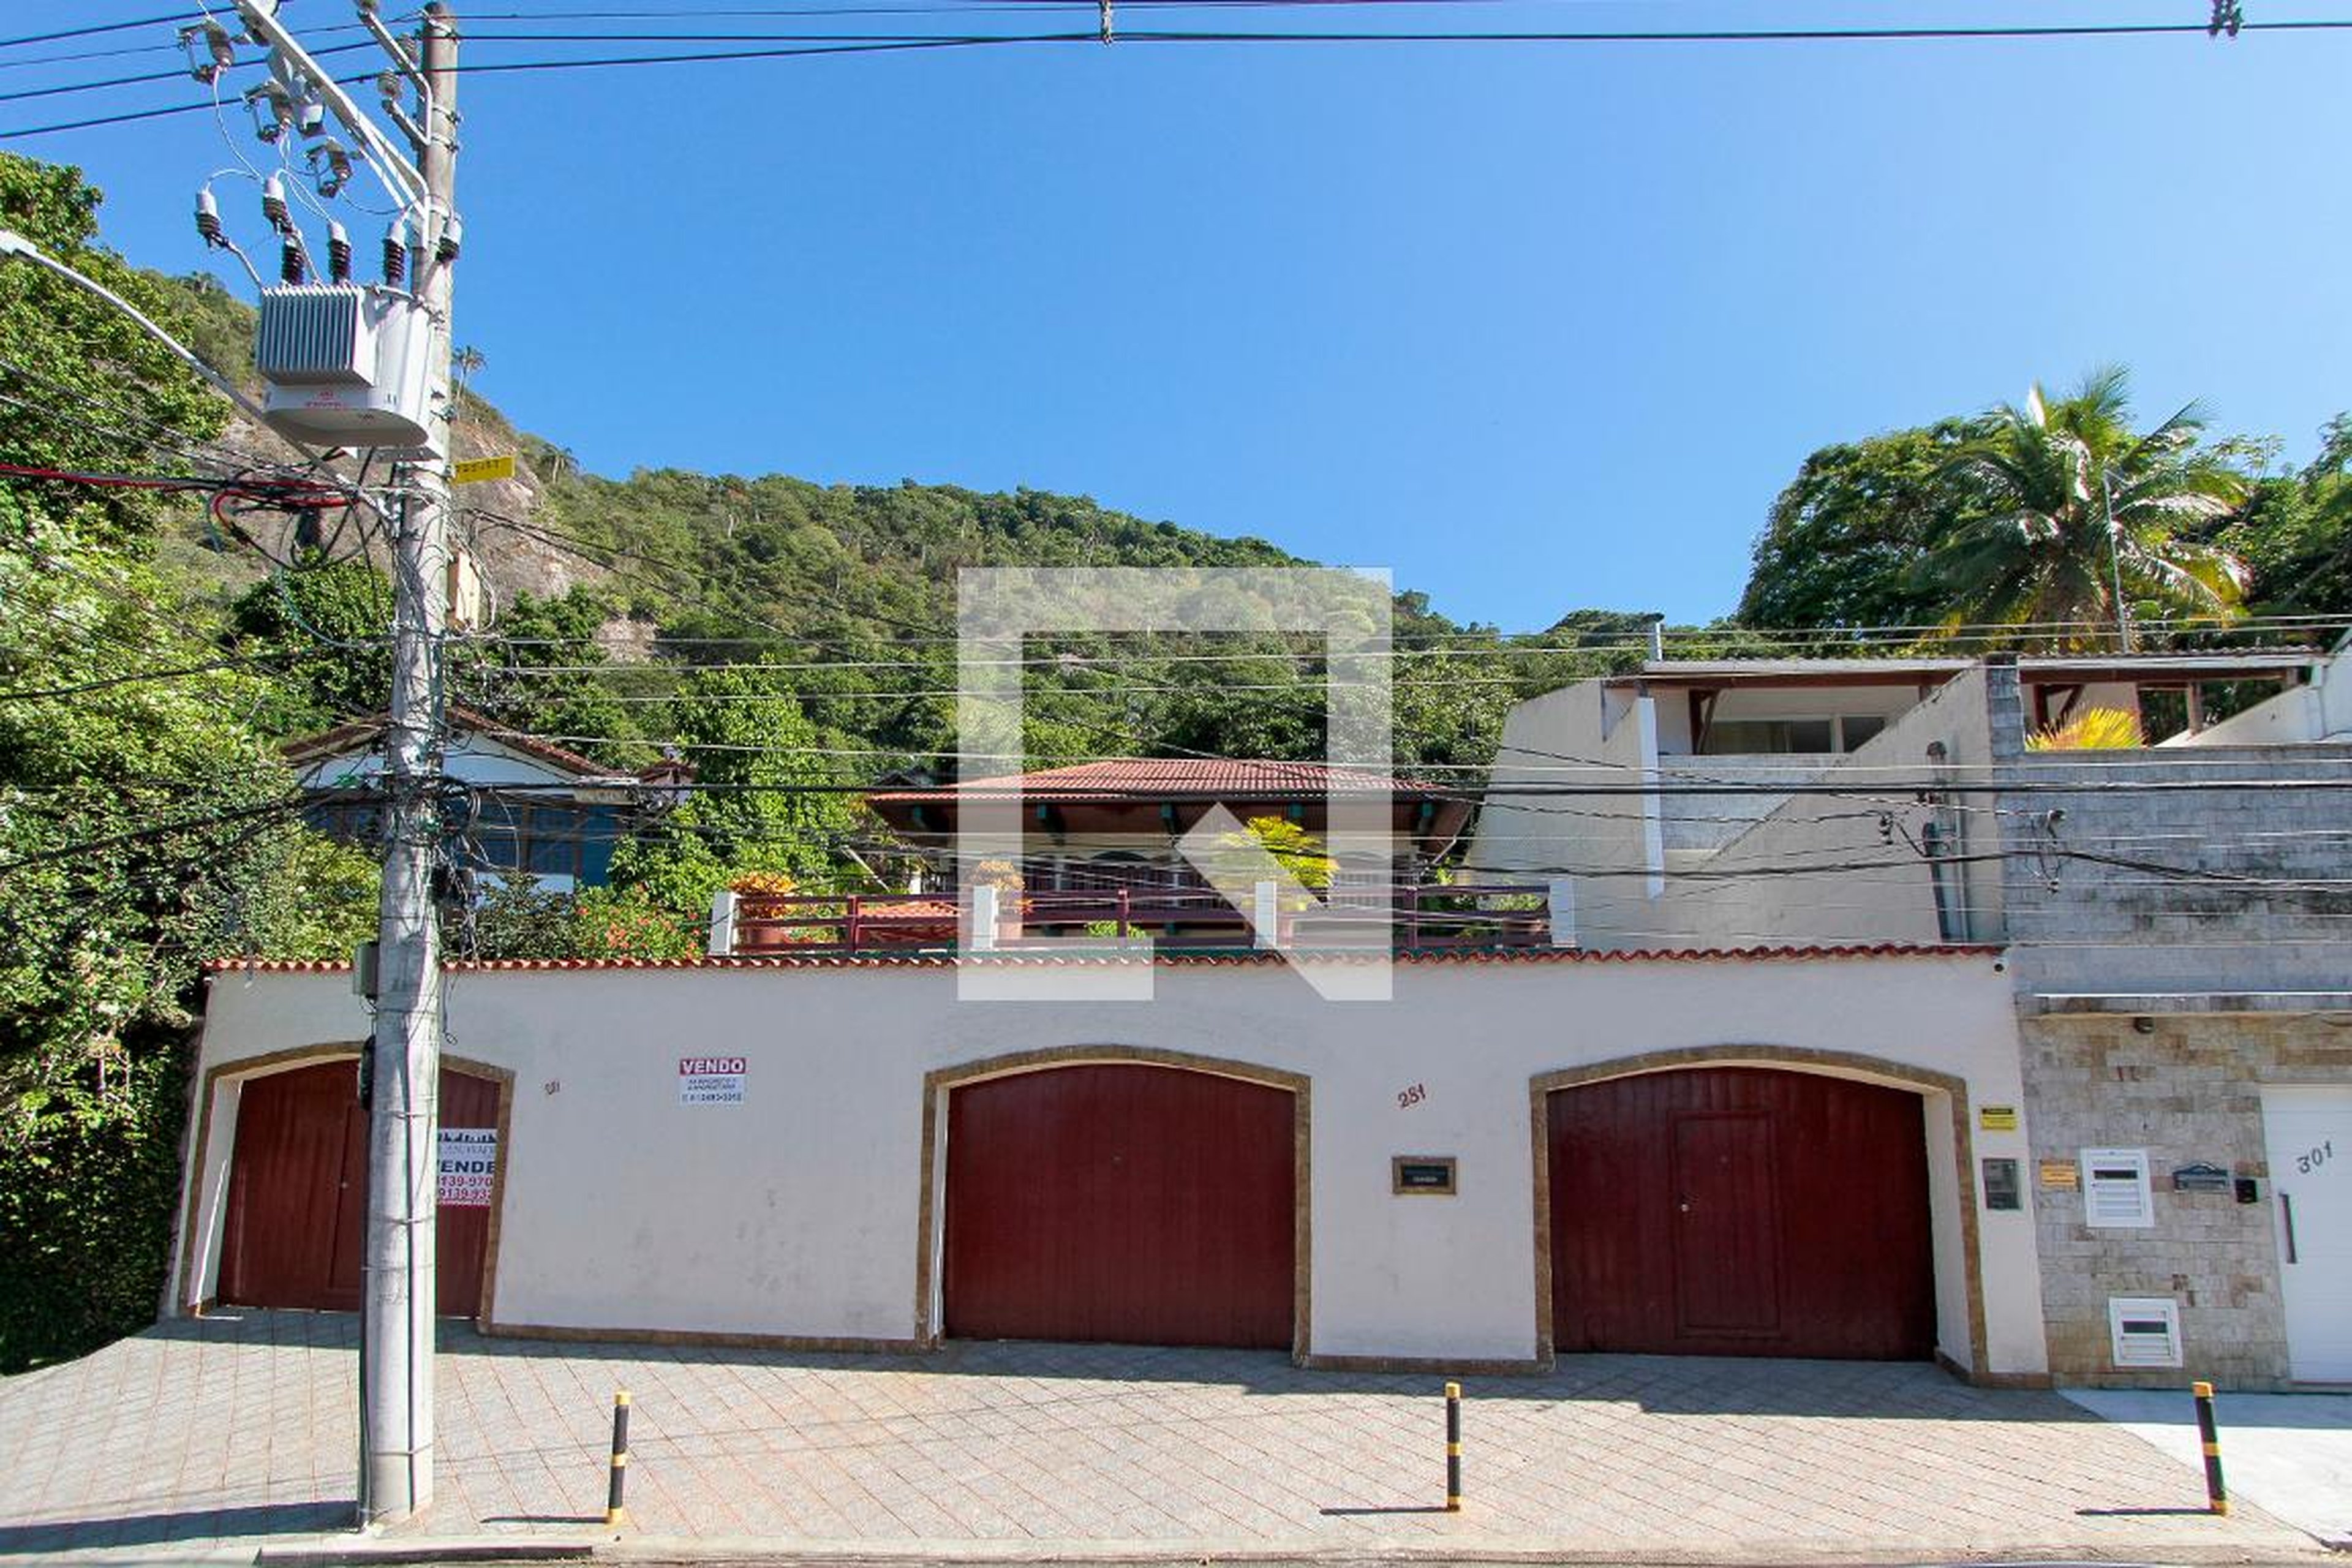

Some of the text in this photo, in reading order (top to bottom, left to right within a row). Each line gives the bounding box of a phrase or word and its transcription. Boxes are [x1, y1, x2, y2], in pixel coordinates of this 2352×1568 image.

[682, 1058, 744, 1072] VENDO
[1398, 1083, 1426, 1107] 281
[2296, 1140, 2332, 1174] 301
